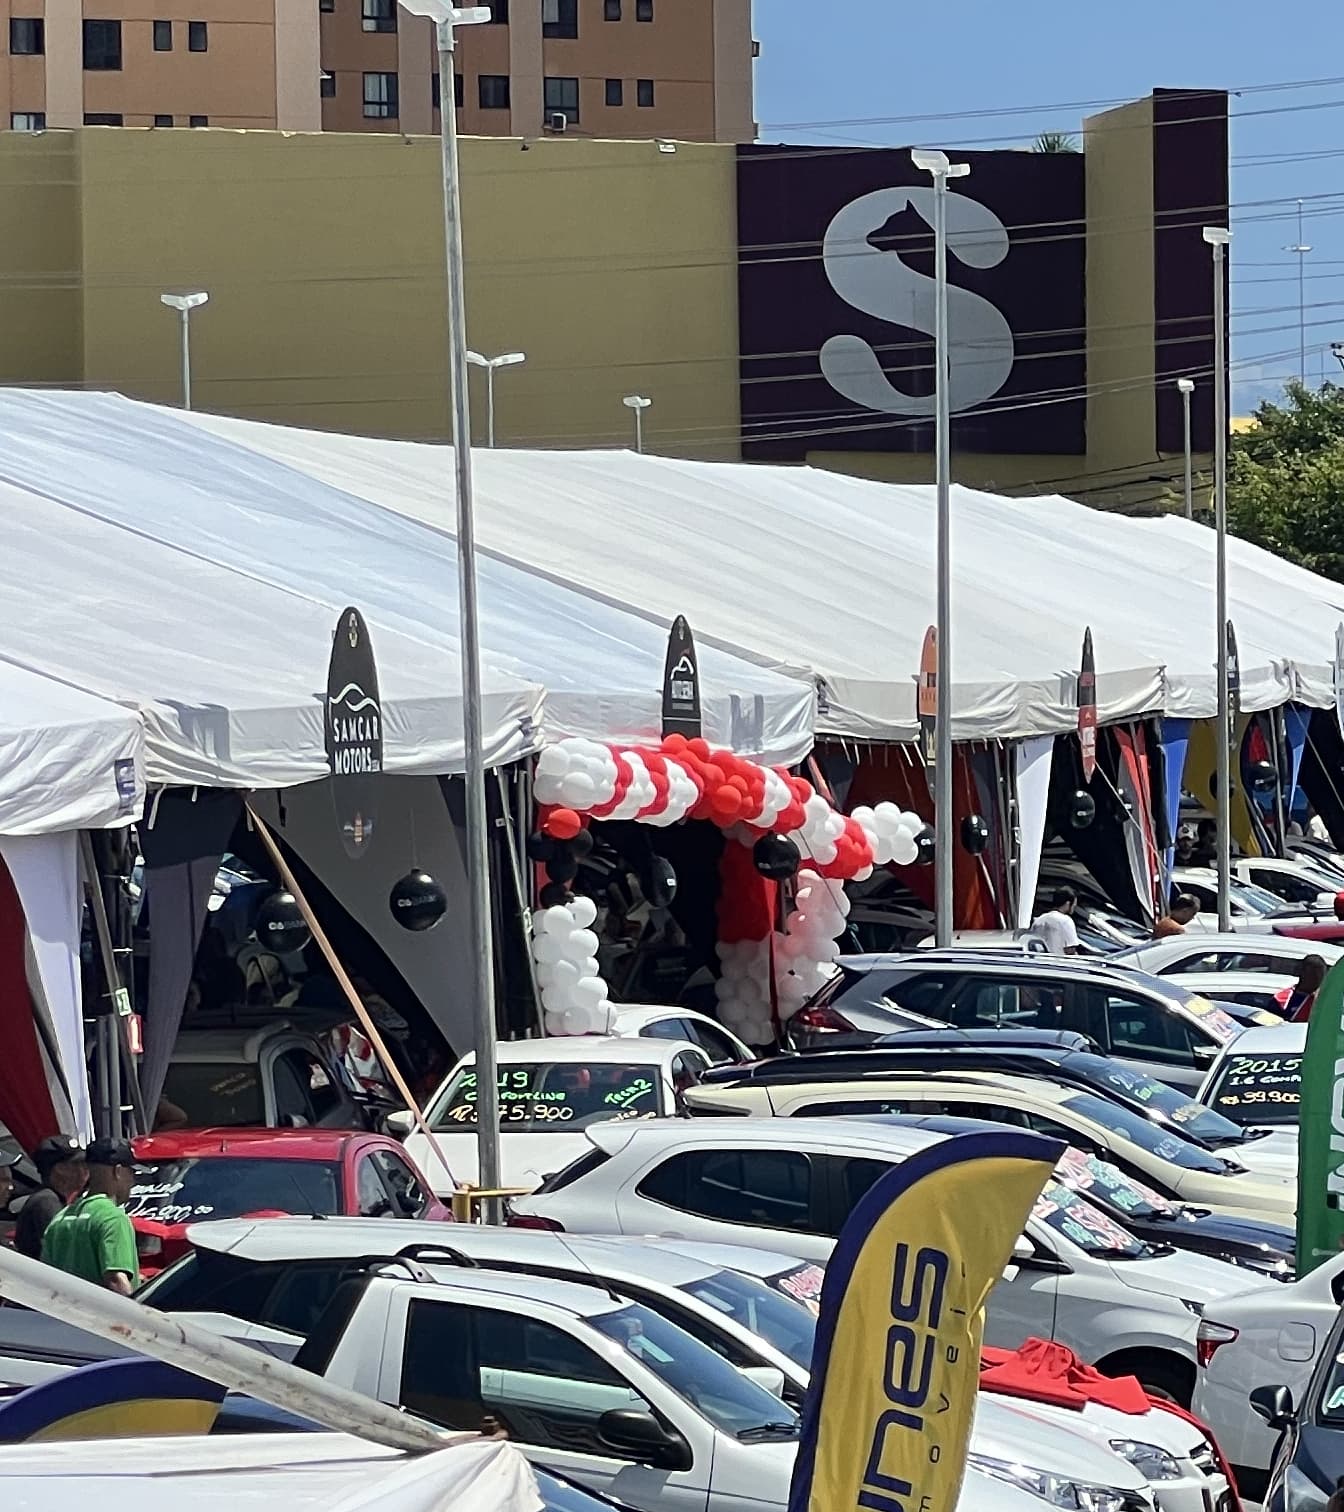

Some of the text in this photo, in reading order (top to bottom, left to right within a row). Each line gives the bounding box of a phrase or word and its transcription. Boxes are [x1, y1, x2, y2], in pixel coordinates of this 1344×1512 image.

[333, 716, 380, 743] SAMCAR
[334, 746, 373, 775] MOTORS
[1229, 1058, 1303, 1076] 2015
